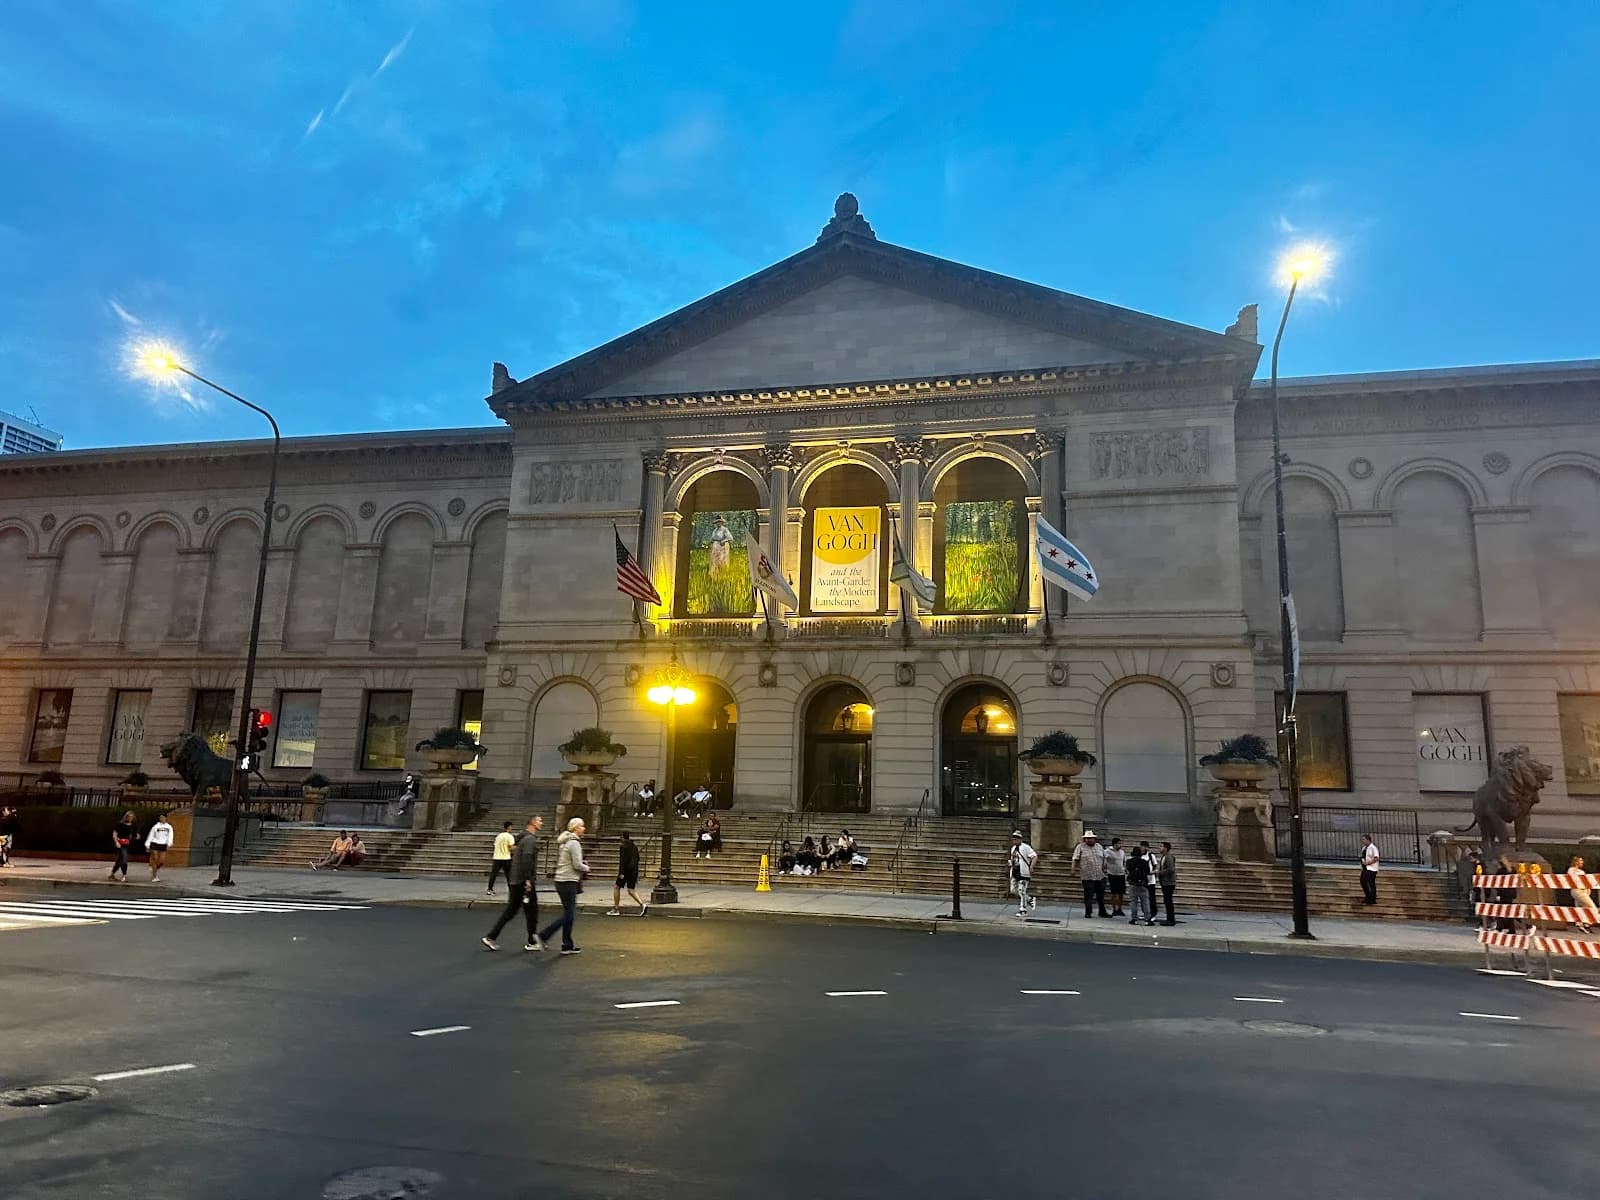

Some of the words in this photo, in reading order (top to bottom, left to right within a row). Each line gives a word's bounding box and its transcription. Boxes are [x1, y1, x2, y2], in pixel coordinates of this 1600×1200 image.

[698, 420, 725, 433] THE
[745, 418, 773, 430] ART
[894, 410, 916, 421] OF
[934, 402, 1007, 419] CHICAGO
[828, 514, 865, 531] VAN
[817, 533, 877, 550] GOGH
[830, 567, 847, 576] and
[849, 567, 863, 576] the
[829, 588, 842, 597] the
[844, 588, 876, 597] Modern
[815, 597, 861, 608] Landscape
[1427, 727, 1467, 743] VAN
[1420, 745, 1482, 761] GOGH
